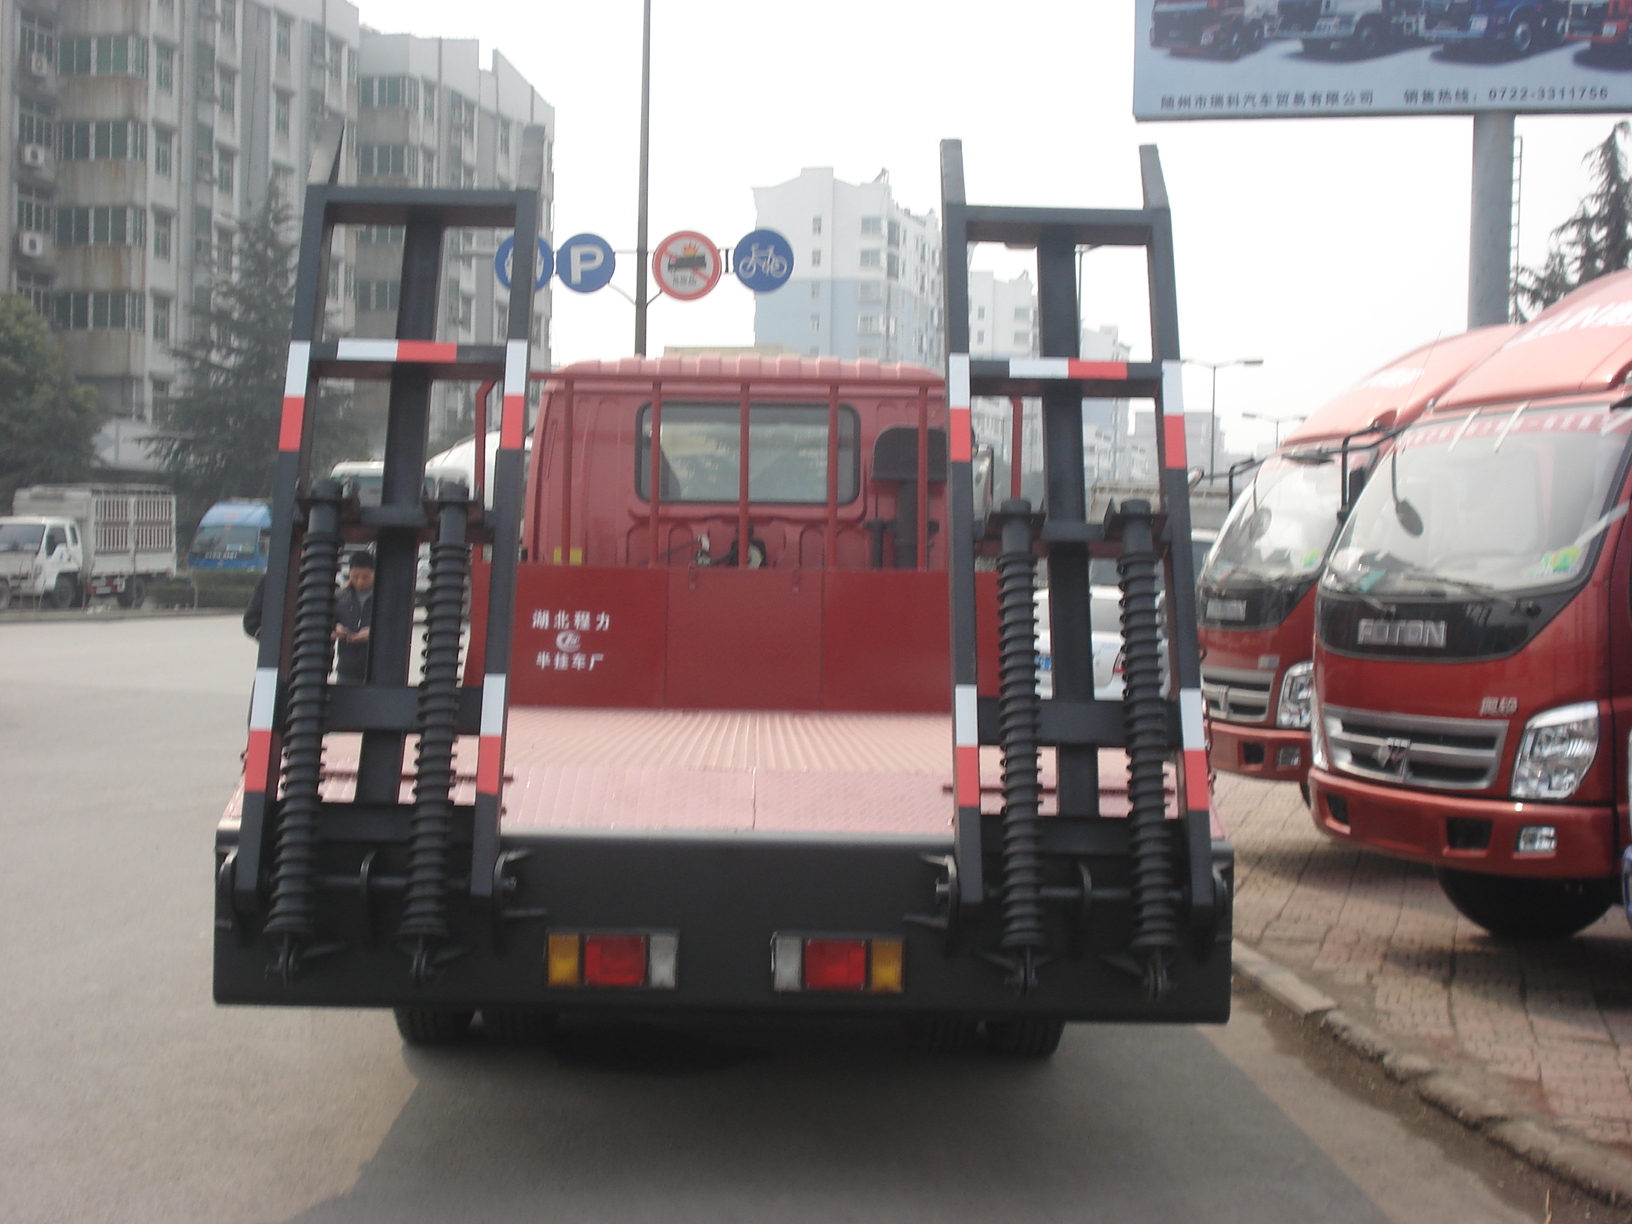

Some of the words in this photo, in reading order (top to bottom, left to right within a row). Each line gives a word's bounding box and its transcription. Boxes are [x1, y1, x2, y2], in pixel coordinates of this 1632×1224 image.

[570, 244, 605, 285] P
[531, 608, 611, 632] 湖北程力
[1356, 618, 1448, 649] FOTON
